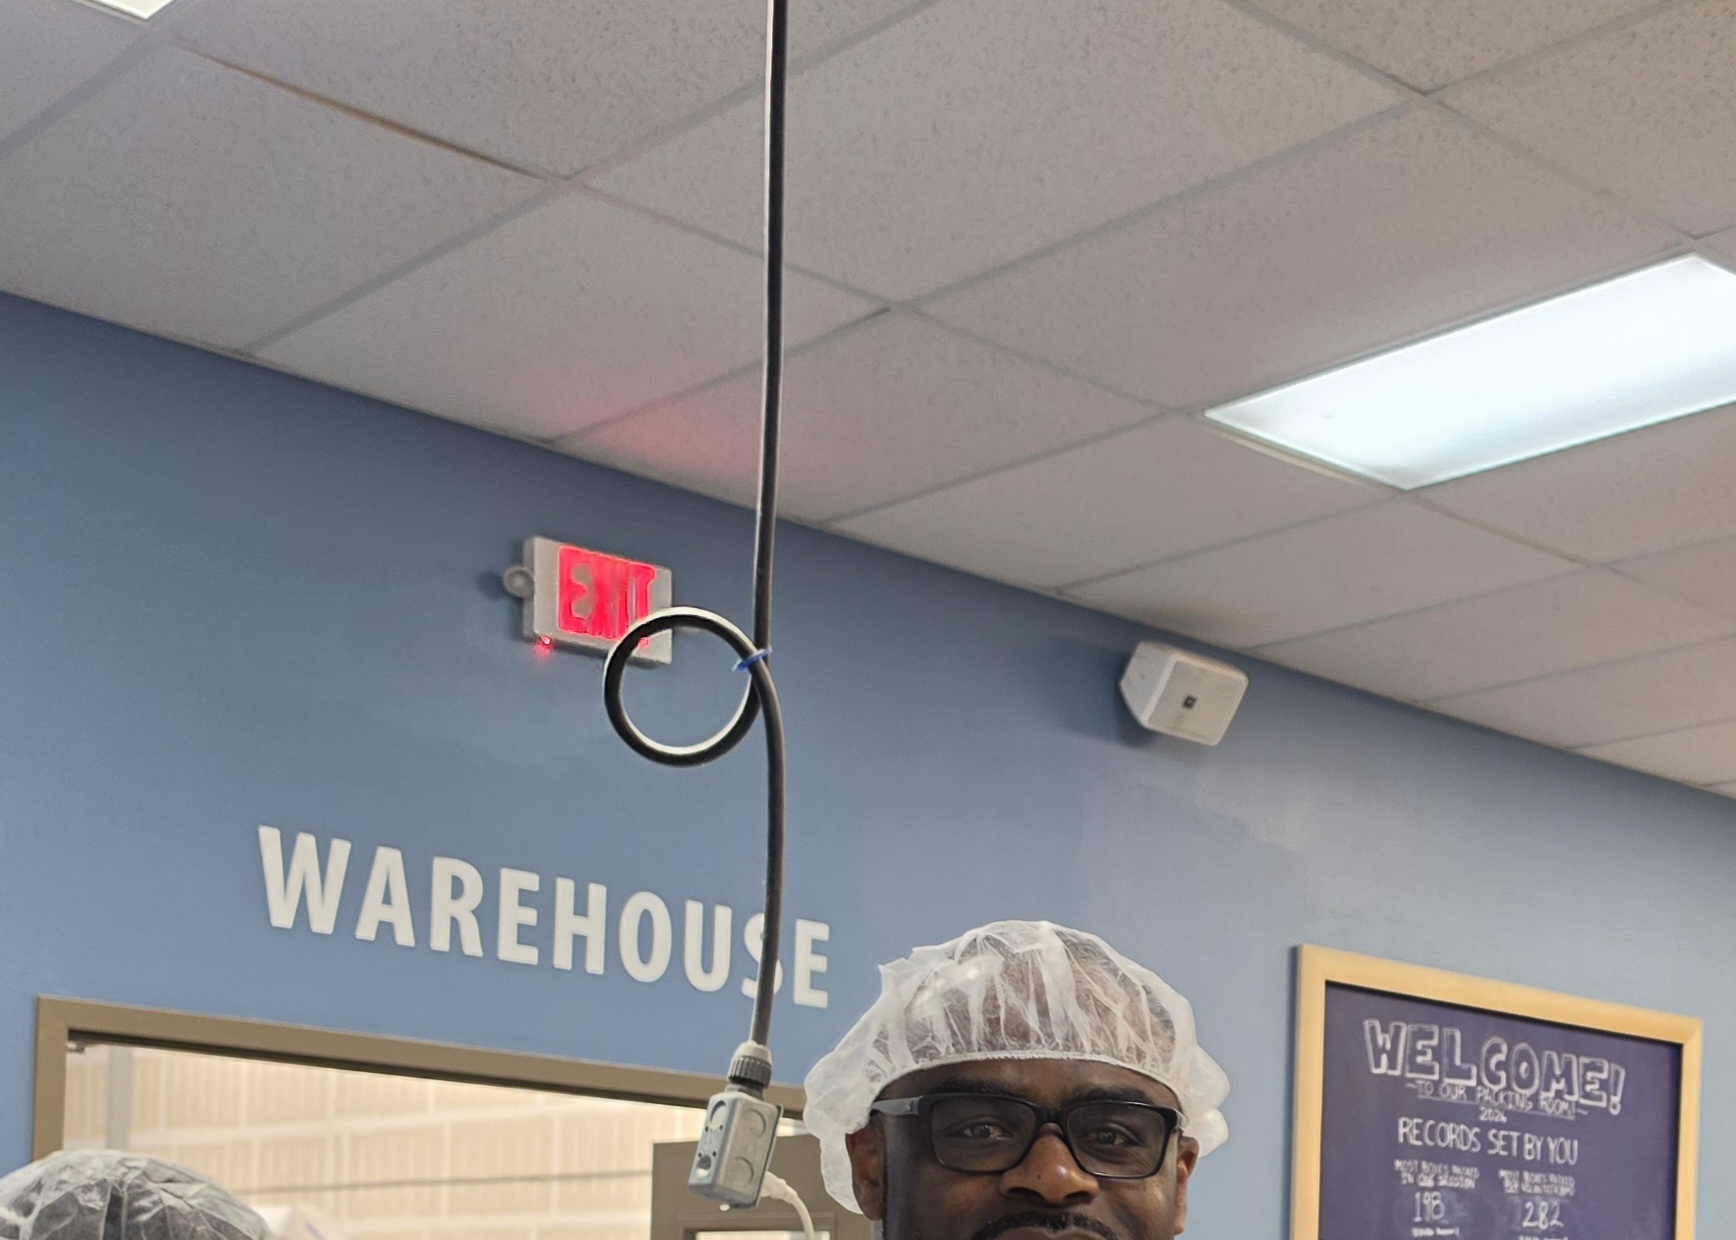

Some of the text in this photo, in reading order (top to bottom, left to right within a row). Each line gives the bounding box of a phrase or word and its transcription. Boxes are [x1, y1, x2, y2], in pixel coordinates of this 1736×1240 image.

[559, 546, 656, 641] EXIT
[258, 825, 829, 1008] WAREHOUSE
[1363, 1018, 1626, 1116] WELCOME!
[1397, 1117, 1579, 1166] RECORDS SET BY YOU
[1522, 1201, 1565, 1229] 282
